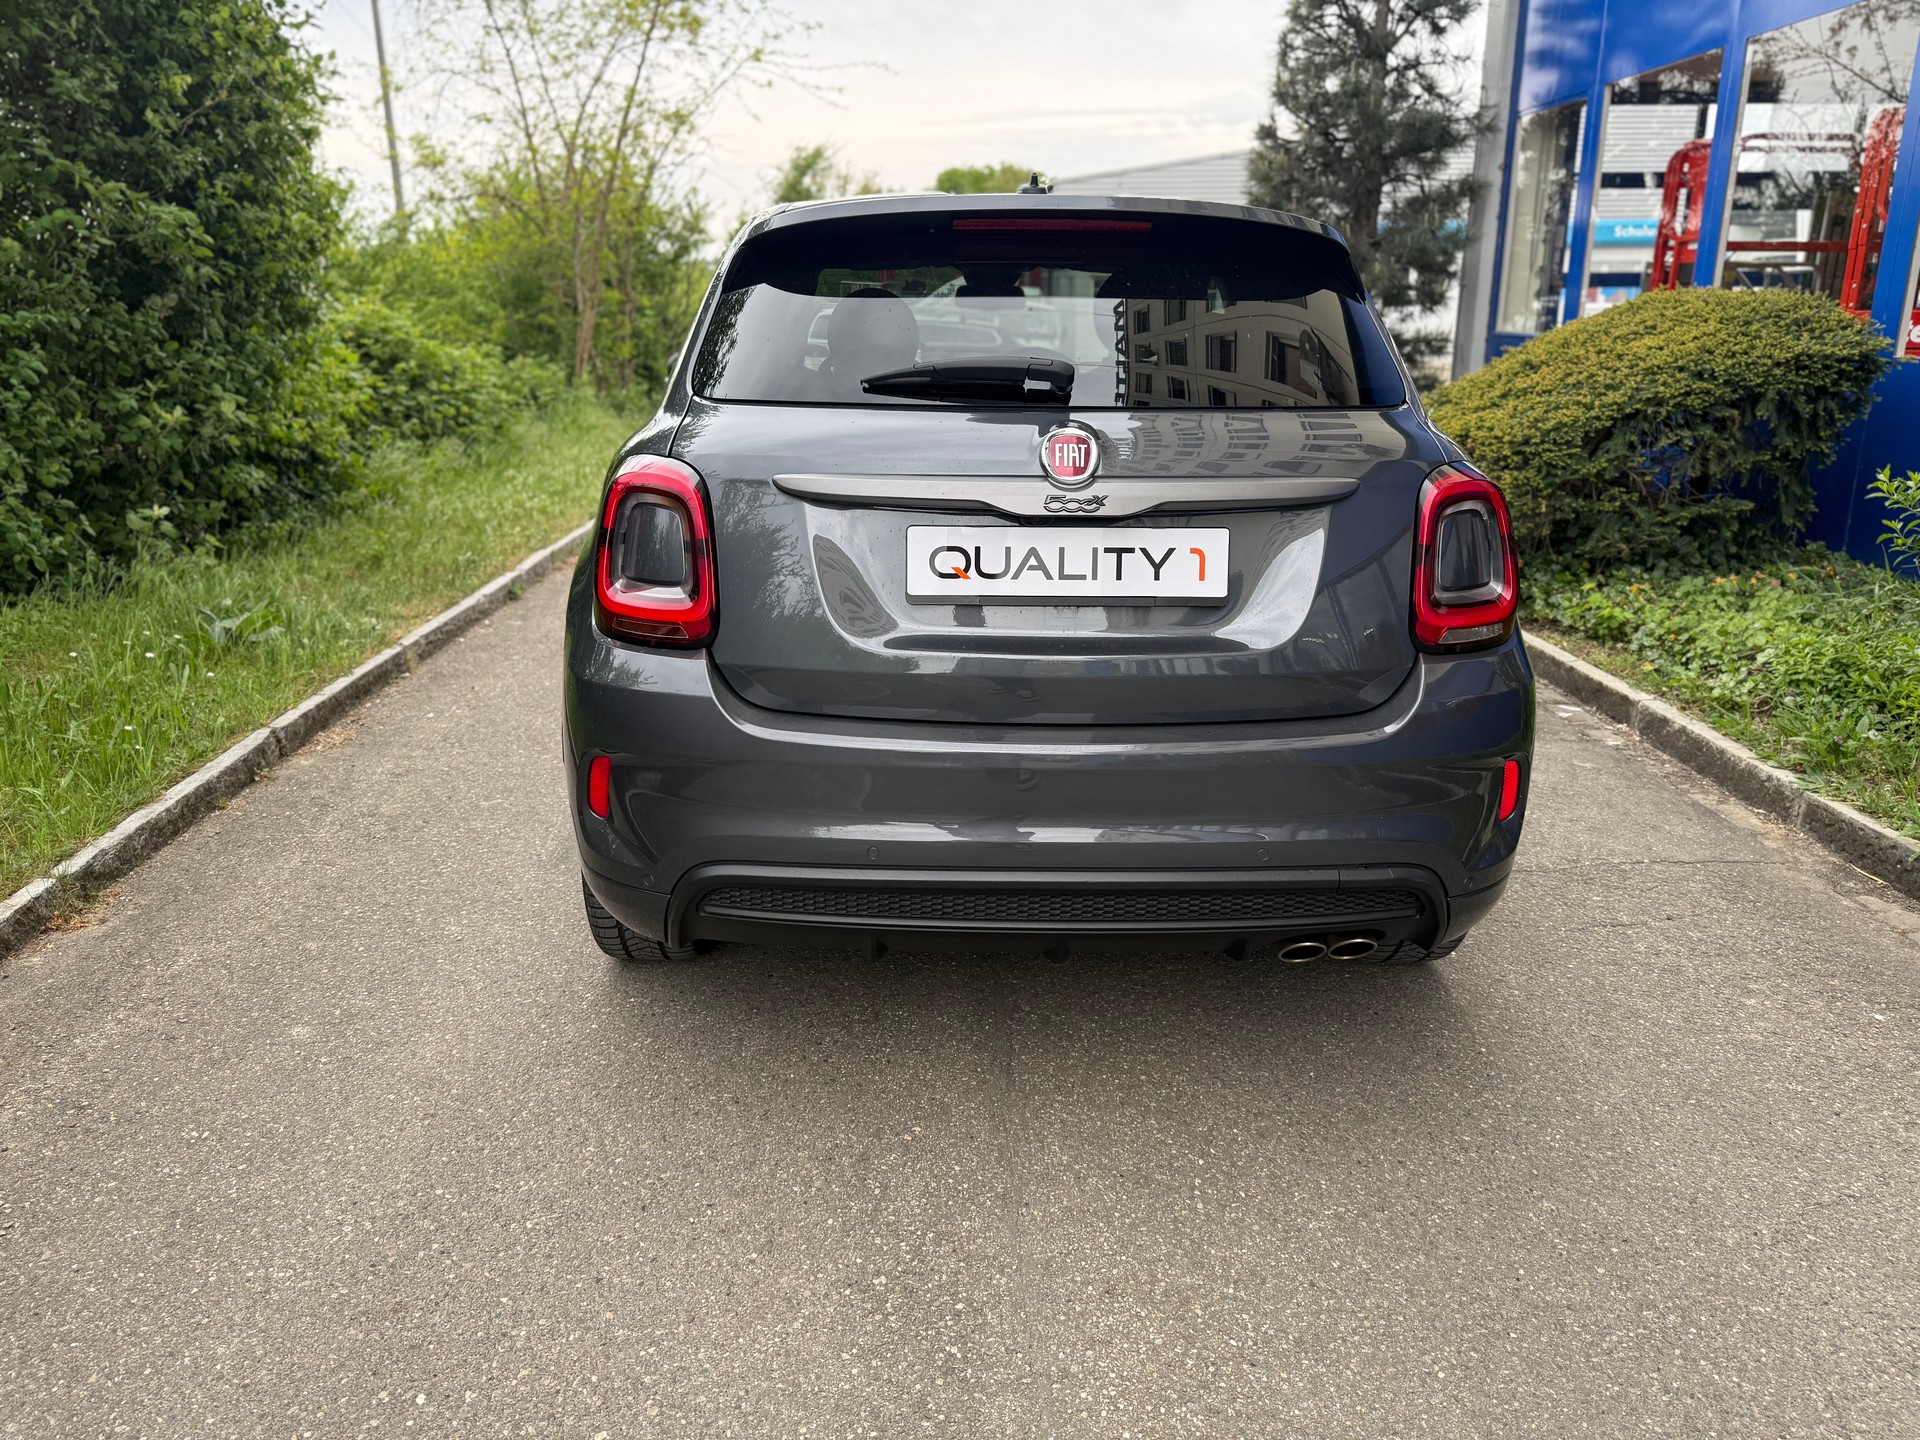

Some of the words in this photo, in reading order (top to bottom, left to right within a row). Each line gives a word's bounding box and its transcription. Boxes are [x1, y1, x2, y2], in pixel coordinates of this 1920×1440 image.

[1054, 443, 1088, 468] FIAT
[929, 545, 1177, 581] QUALITY
[1189, 547, 1206, 581] 1
